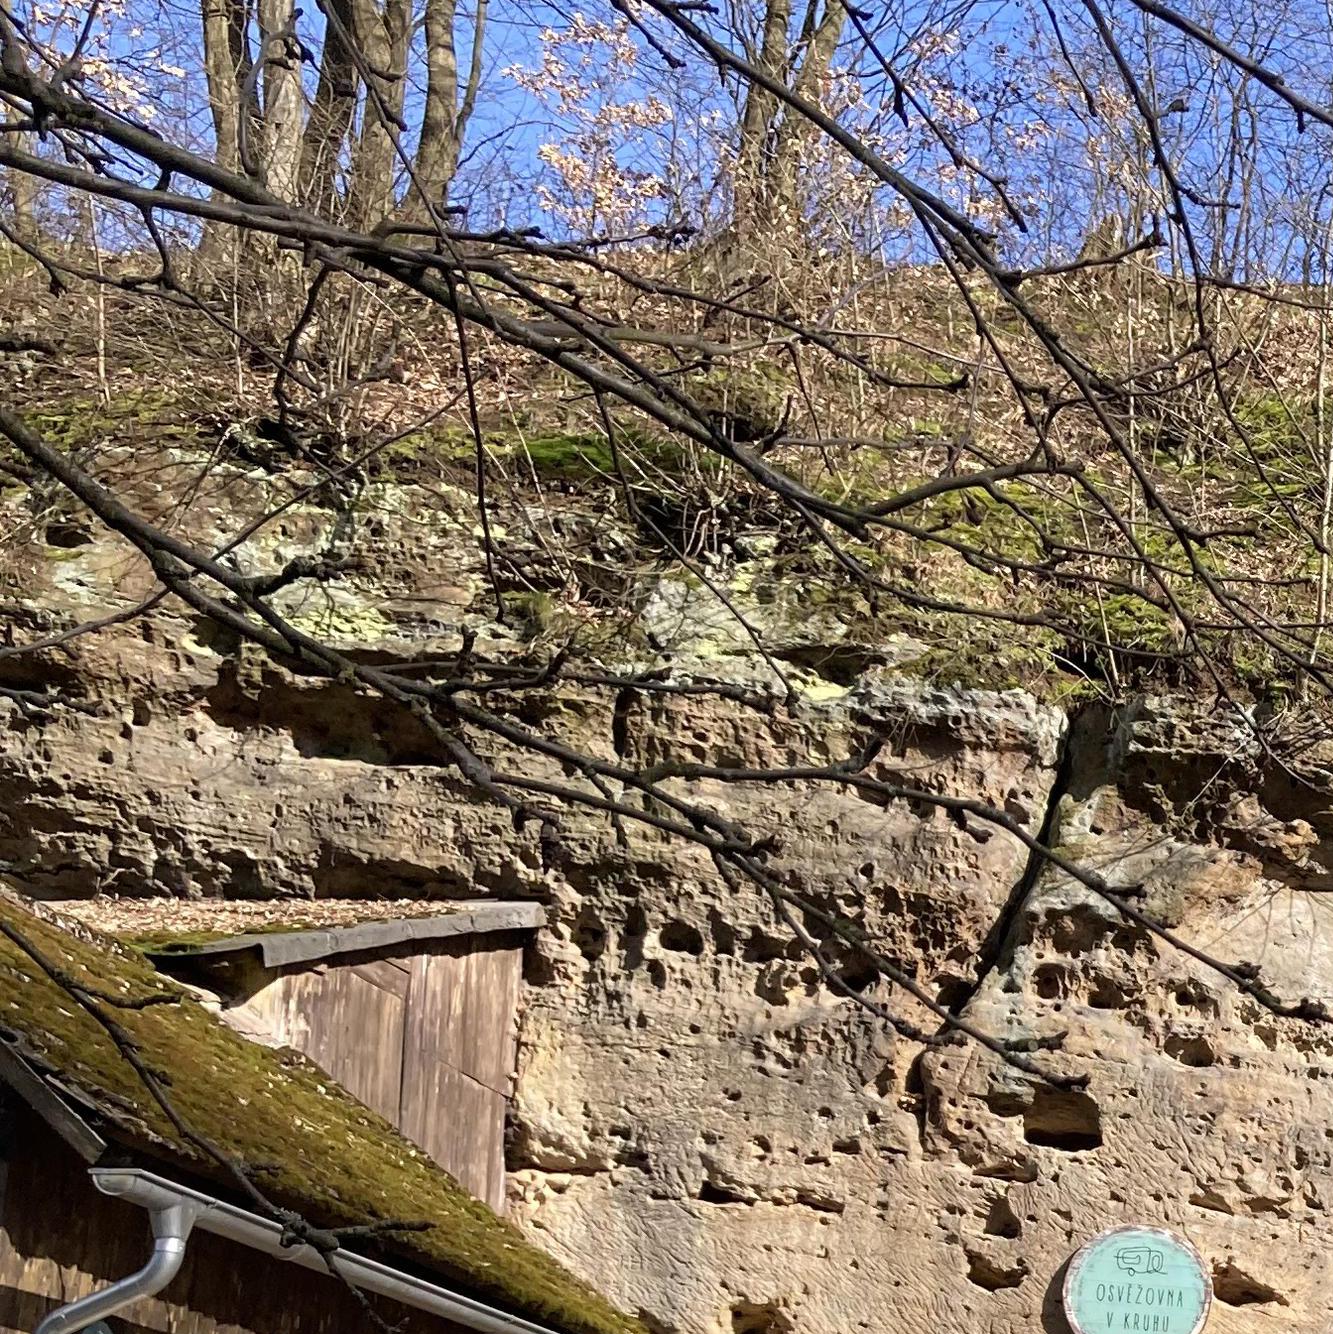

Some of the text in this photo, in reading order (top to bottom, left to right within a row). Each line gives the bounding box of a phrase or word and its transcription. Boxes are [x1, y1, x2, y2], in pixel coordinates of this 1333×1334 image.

[1096, 1283, 1184, 1307] OSVĚŽOVNA
[1107, 1312, 1169, 1332] V KRUHU
